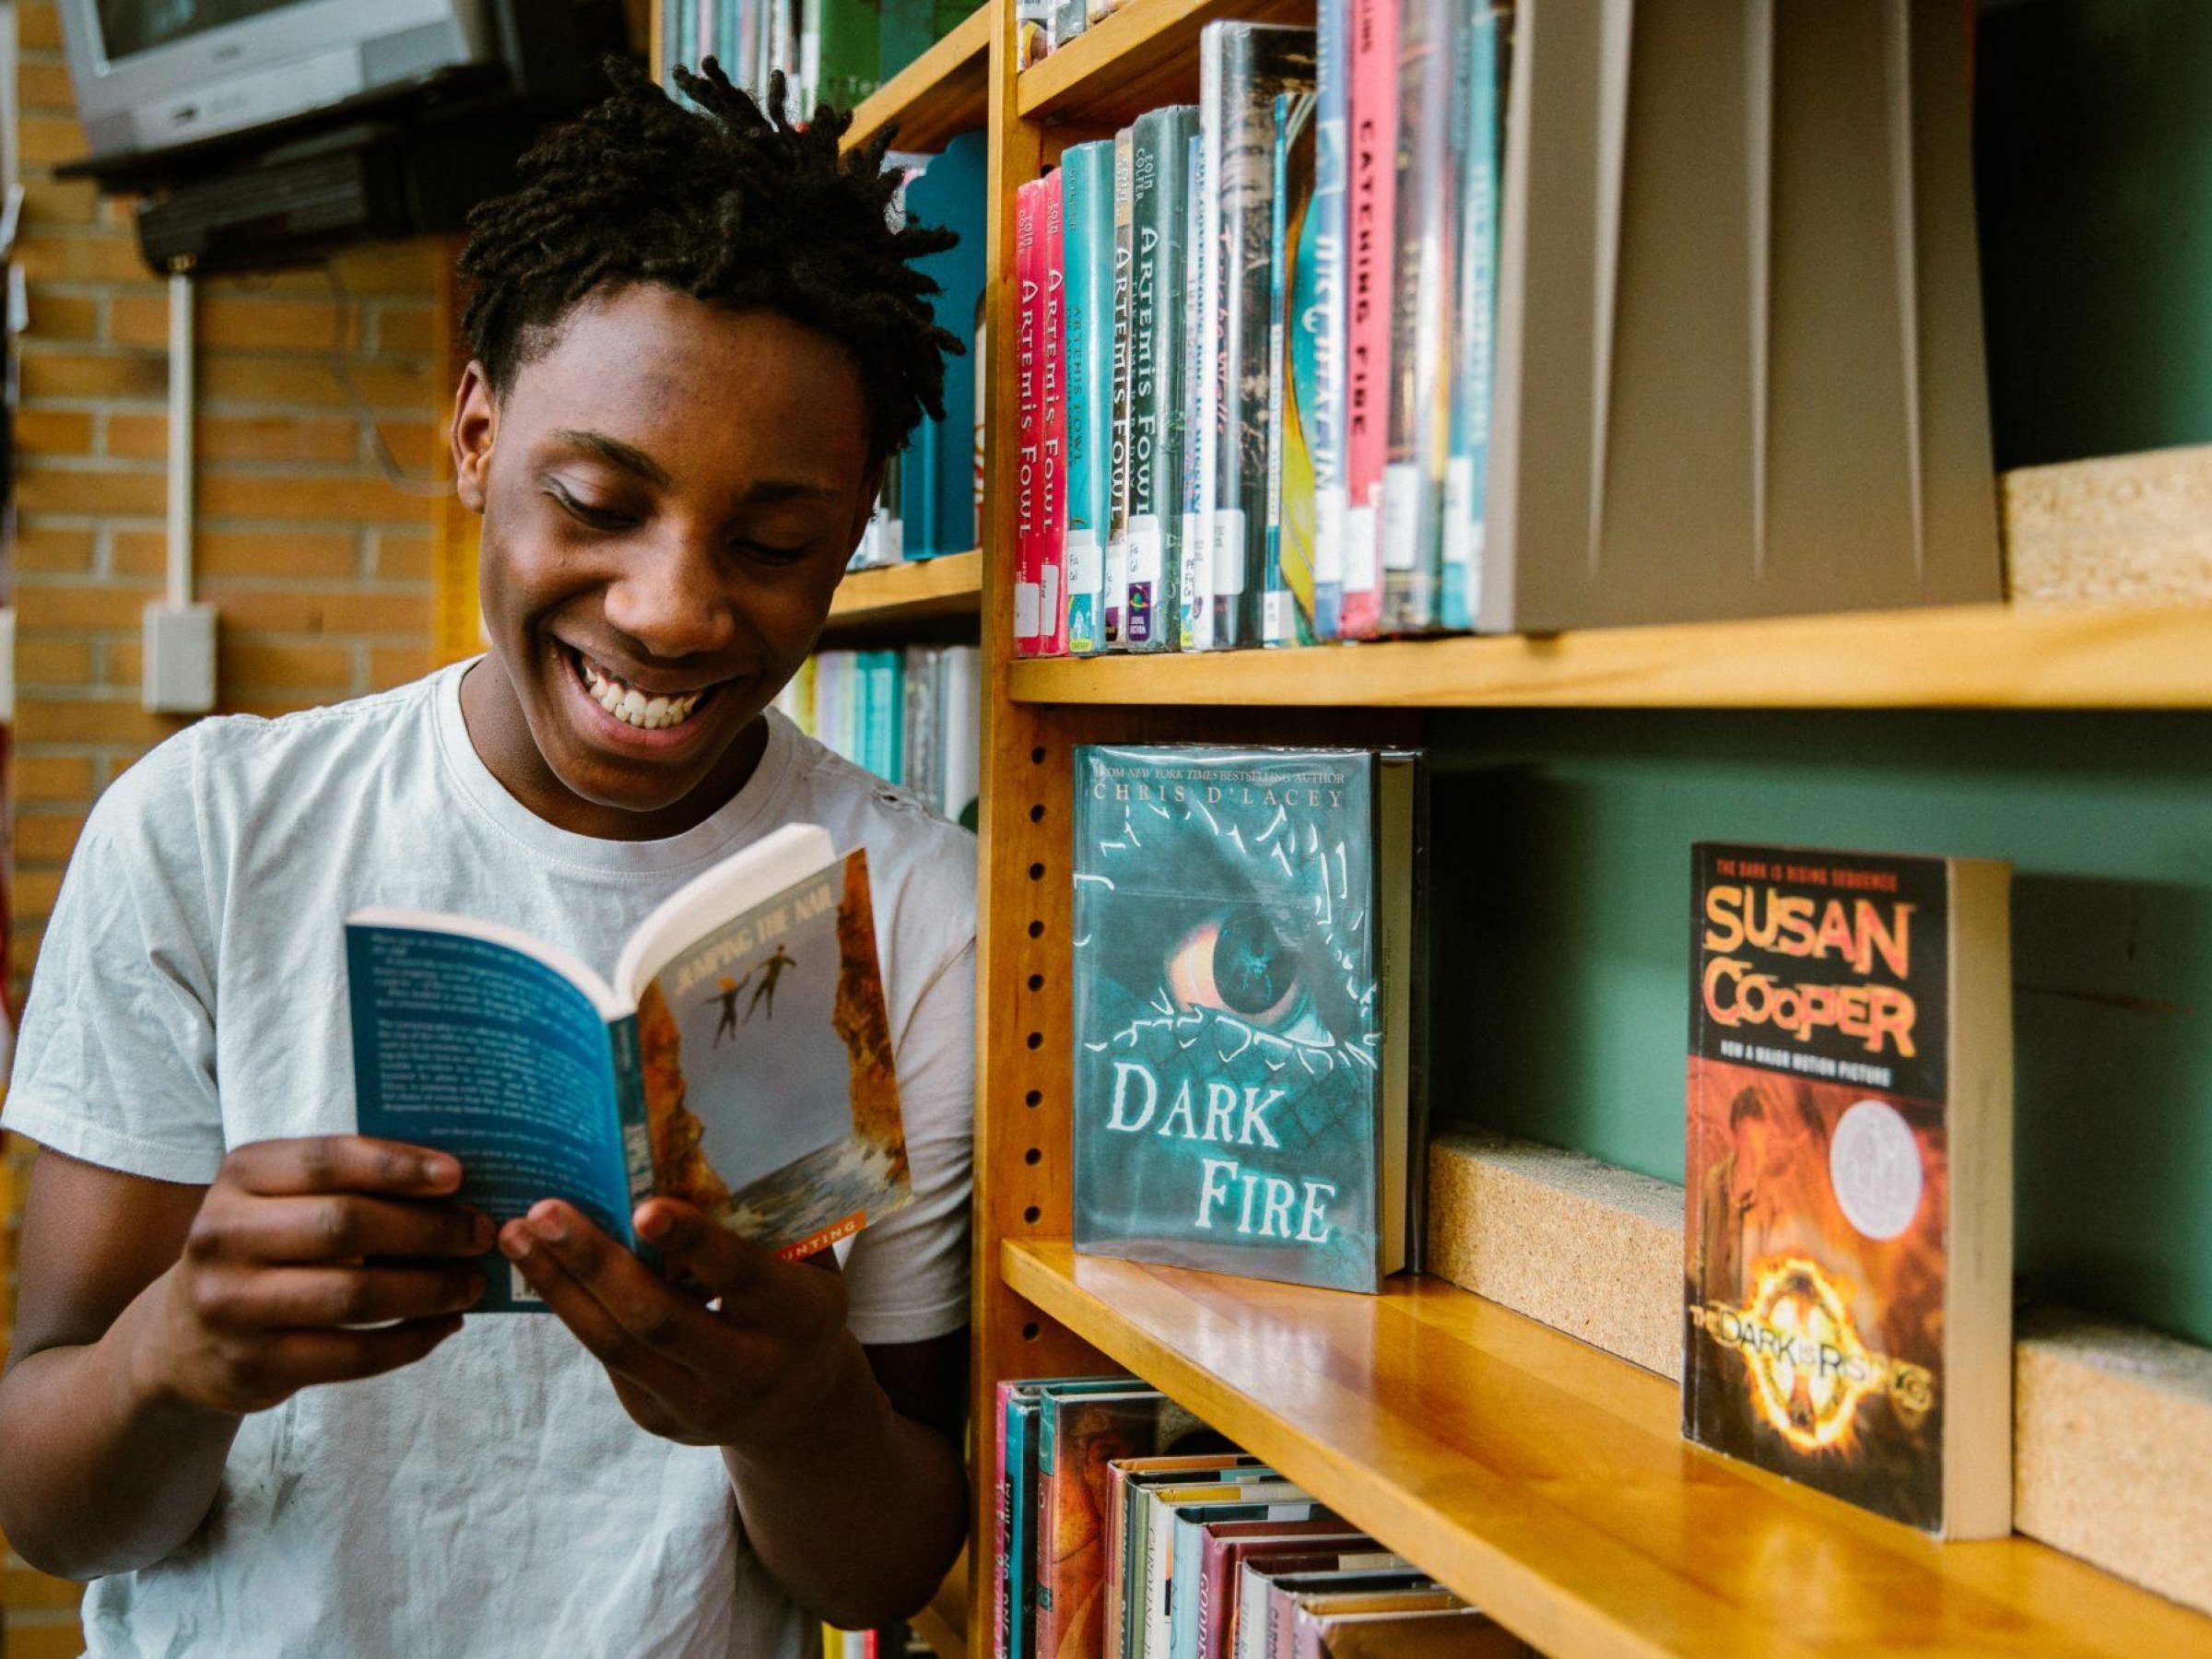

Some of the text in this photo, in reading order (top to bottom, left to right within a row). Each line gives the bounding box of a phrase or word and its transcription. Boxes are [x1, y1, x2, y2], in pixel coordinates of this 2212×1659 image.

[1353, 119, 1376, 434] CATCHING FIRE
[1110, 419, 1127, 522] FOWL
[1094, 784, 1343, 808] CHRIS D'LACEY
[1127, 768, 1151, 779] NEW
[1154, 769, 1183, 780] YORK
[1186, 770, 1219, 781] TIMES
[1219, 771, 1289, 783] BESTSELLING
[1294, 772, 1345, 784] AUTHOR
[1702, 885, 1918, 980] SUSAN
[1703, 957, 1917, 1058] COOPER
[1106, 1061, 1287, 1149] DARK
[782, 1221, 856, 1261] UNTING
[1194, 1159, 1337, 1243] FIRE
[1720, 1310, 1797, 1367] DARK
